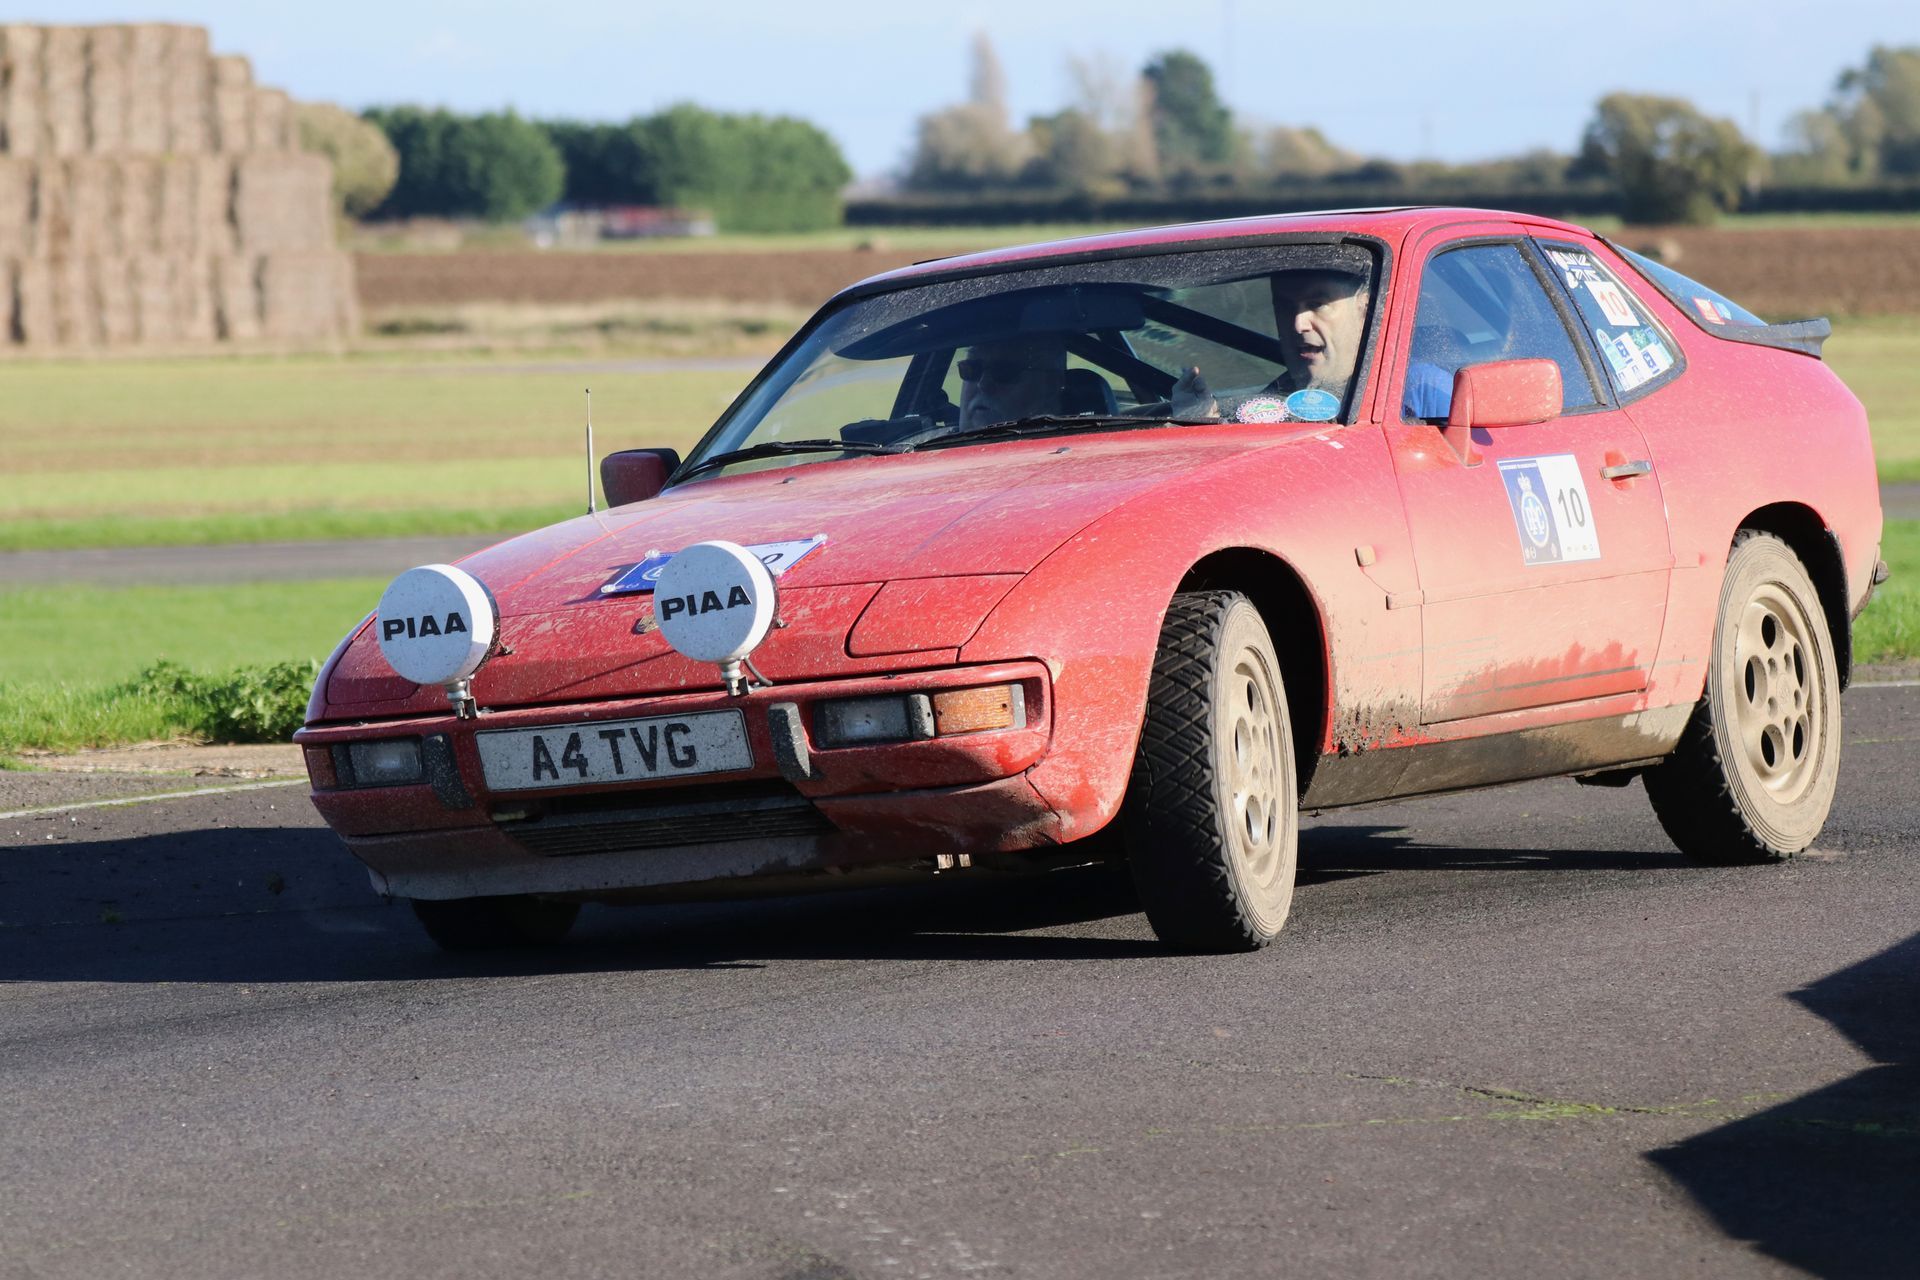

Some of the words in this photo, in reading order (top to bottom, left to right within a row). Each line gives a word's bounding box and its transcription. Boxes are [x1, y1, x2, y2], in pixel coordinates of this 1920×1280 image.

[1600, 291, 1628, 317] 10
[1558, 488, 1585, 528] 10
[661, 585, 752, 622] PIAA
[383, 612, 467, 641] PIAA
[532, 732, 589, 781] A4
[599, 722, 697, 775] TVG
